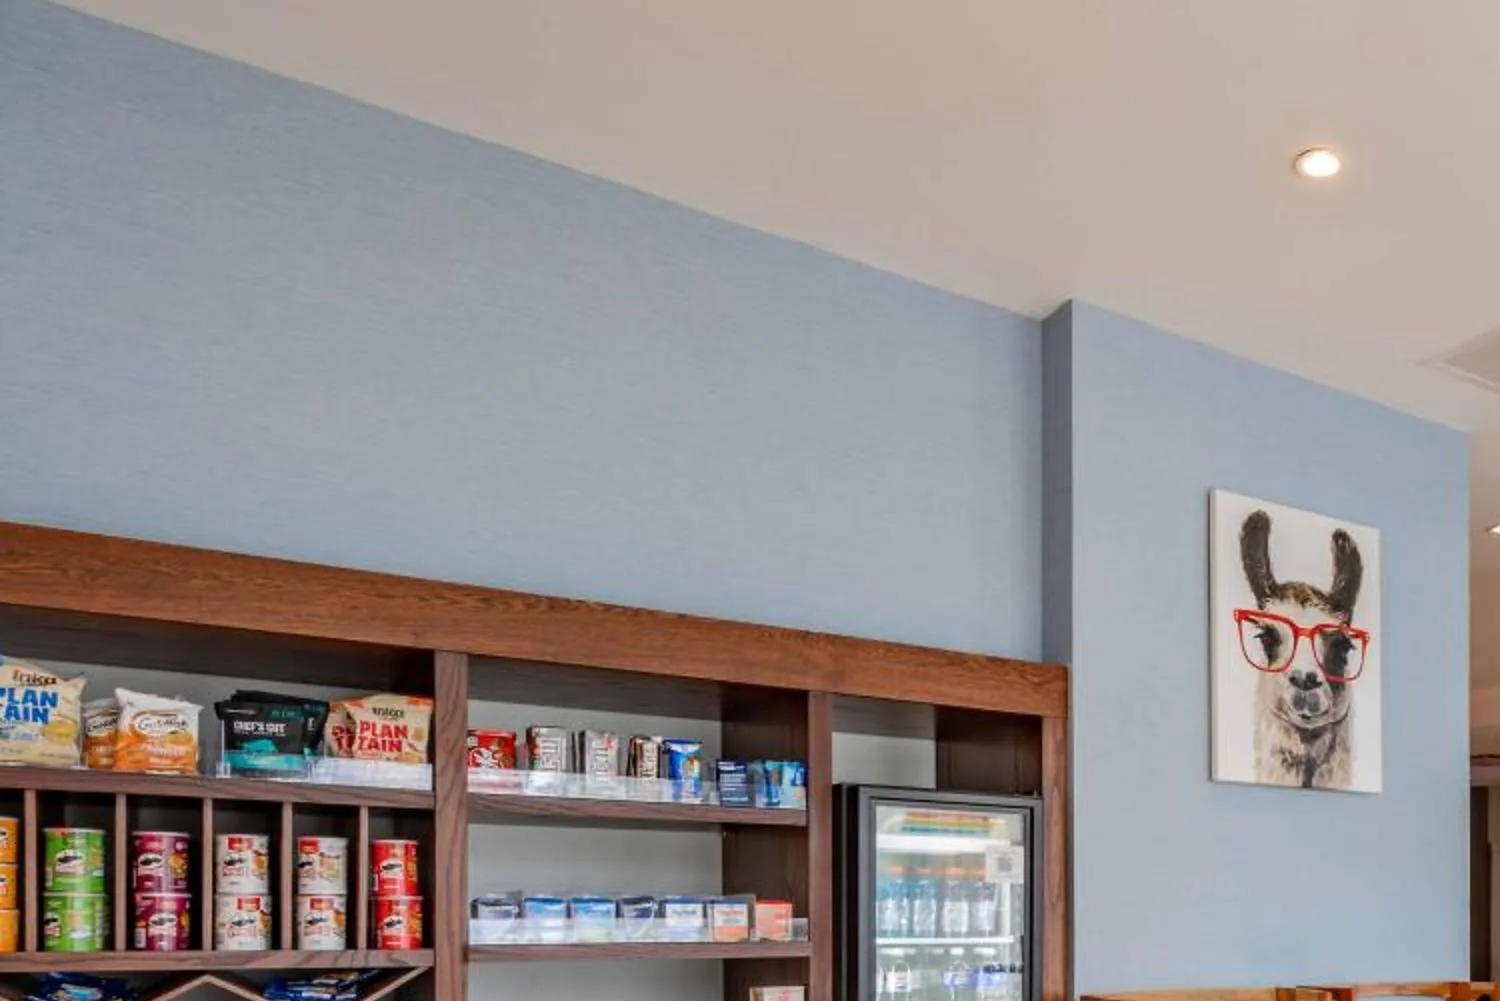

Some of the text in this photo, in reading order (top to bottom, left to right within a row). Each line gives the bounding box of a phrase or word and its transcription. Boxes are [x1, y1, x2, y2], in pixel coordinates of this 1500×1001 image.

[0, 703, 49, 724] AIN
[359, 720, 408, 738] PLAN
[357, 735, 402, 752] TAIN
